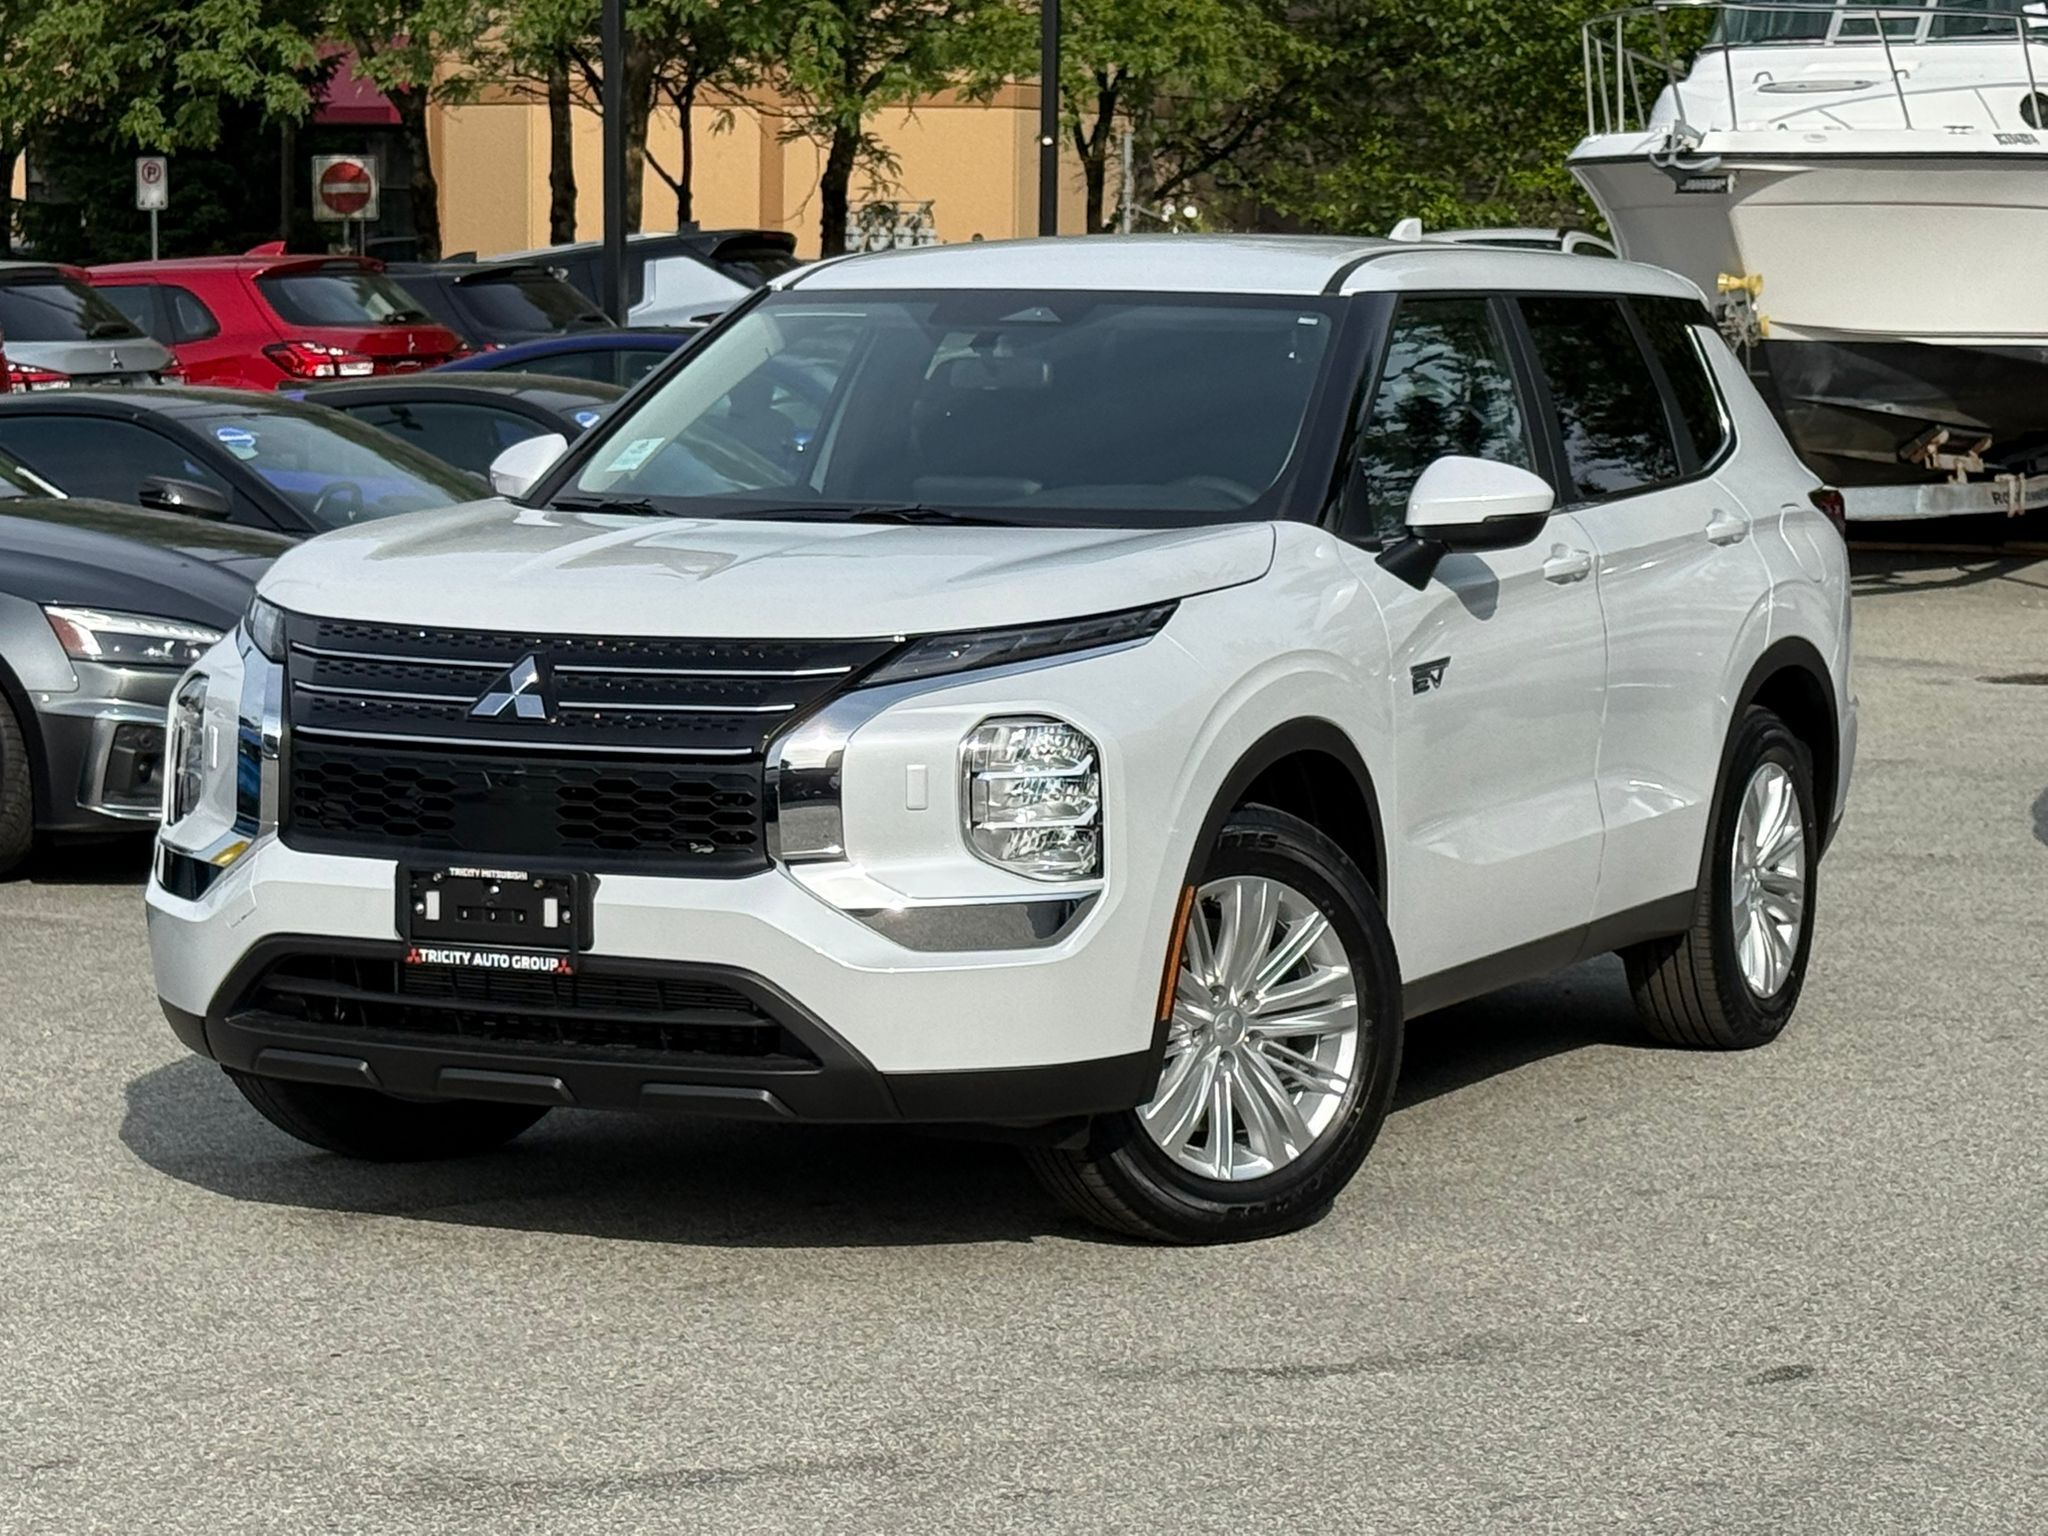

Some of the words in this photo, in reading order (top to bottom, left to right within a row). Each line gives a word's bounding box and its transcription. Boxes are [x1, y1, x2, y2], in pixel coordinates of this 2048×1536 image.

[418, 949, 471, 964] TRICITY
[472, 952, 510, 967] AUTO
[511, 955, 559, 971] GROUP
